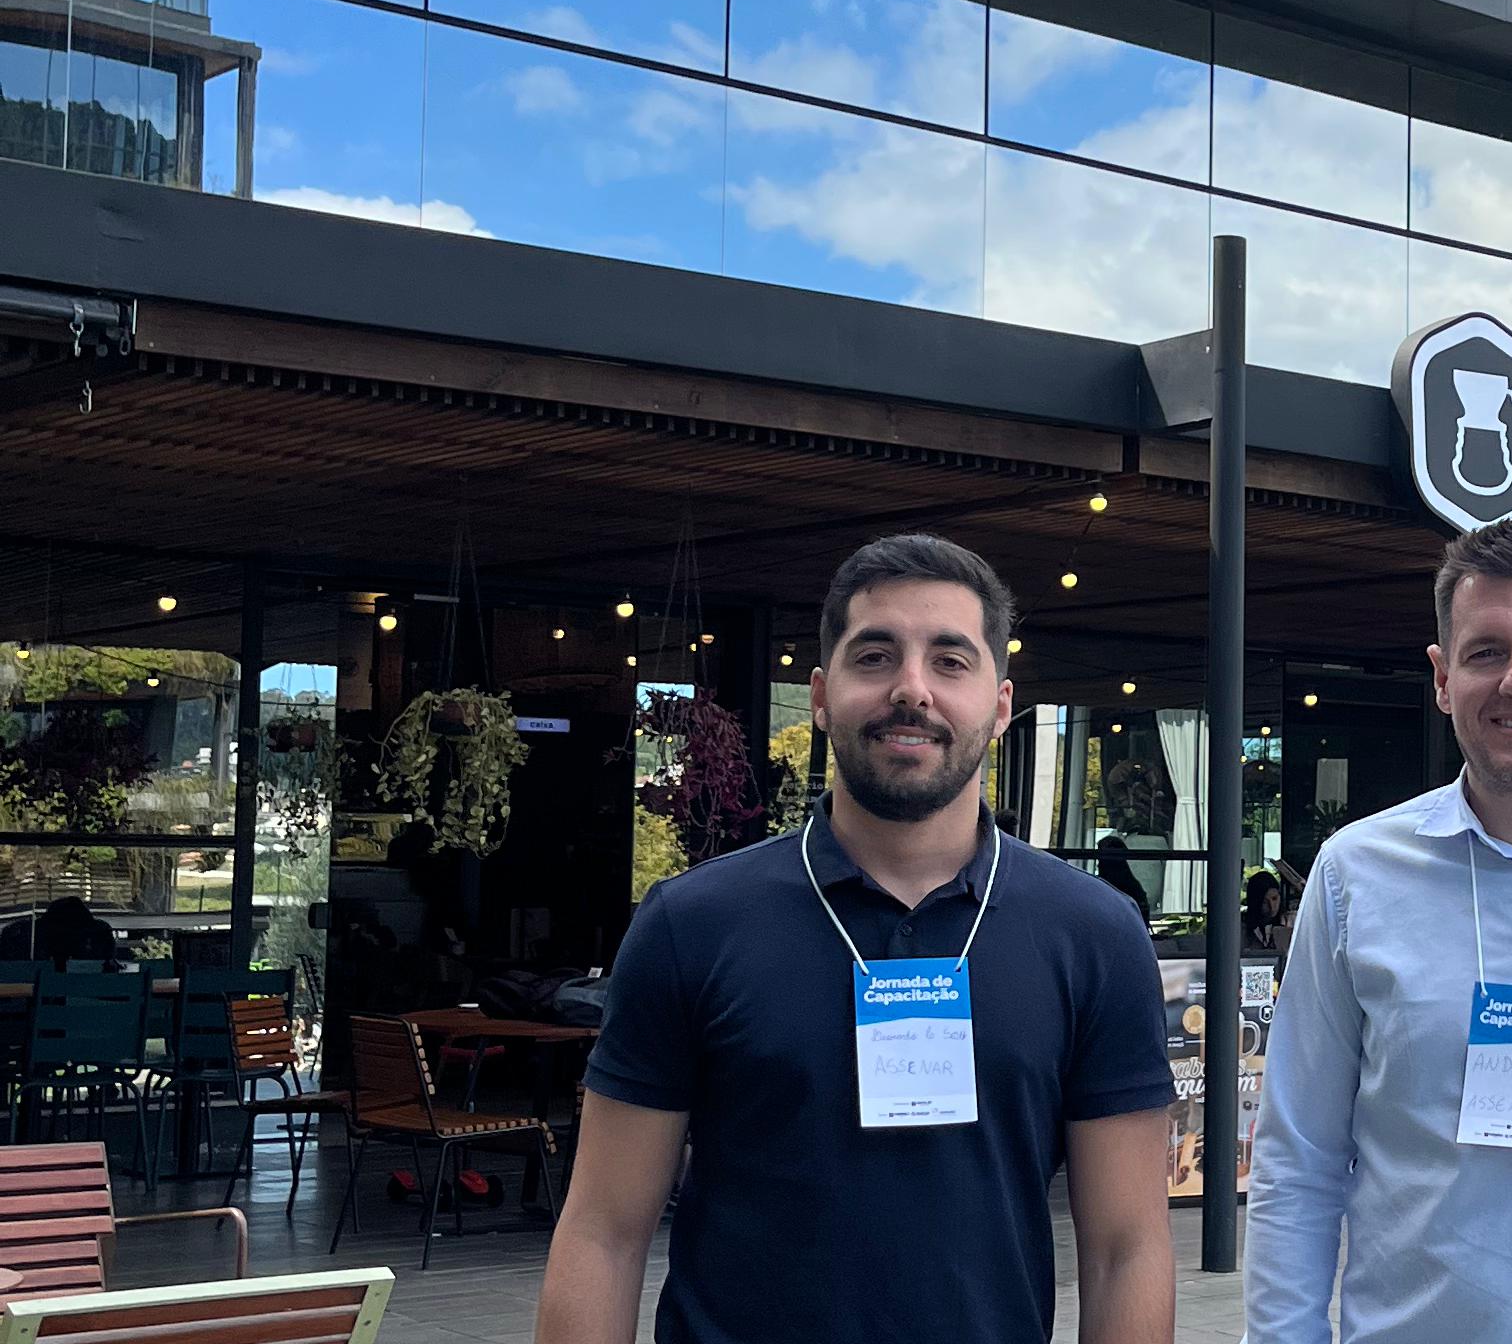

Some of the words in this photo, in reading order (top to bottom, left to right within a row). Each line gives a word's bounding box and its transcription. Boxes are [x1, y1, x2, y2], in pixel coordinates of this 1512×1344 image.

[869, 976, 931, 990] Jornada
[932, 975, 953, 988] de
[863, 987, 959, 1006] Capacitação
